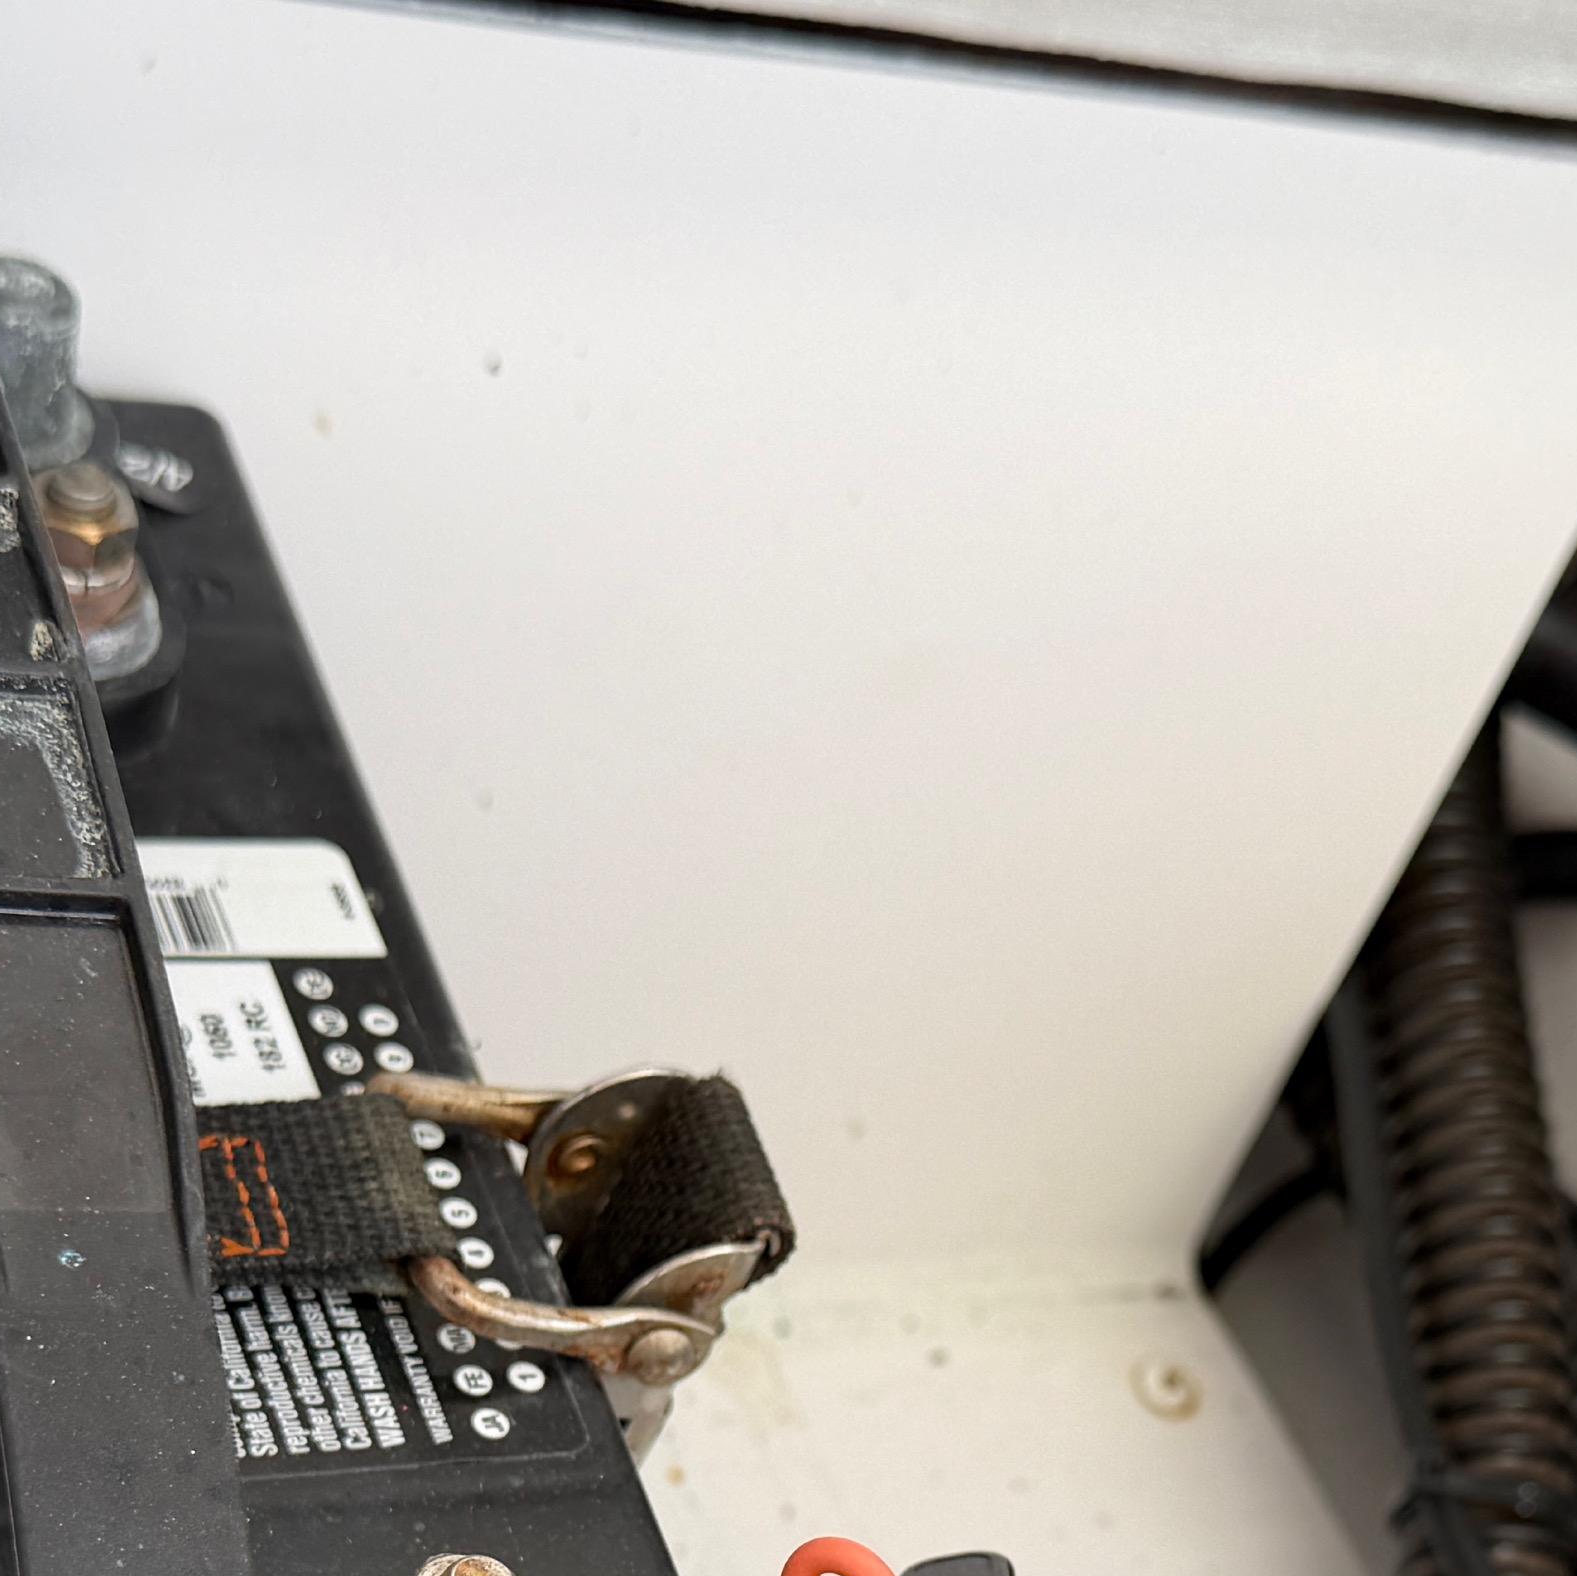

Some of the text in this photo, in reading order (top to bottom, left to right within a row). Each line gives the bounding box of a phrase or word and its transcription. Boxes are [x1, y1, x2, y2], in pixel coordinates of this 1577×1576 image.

[297, 1300, 336, 1350] cause
[384, 1315, 419, 1355] VOID
[274, 1323, 326, 1406] chemicals
[316, 1349, 344, 1369] to
[338, 1329, 386, 1391] HANDS
[253, 1351, 311, 1455] reproductive
[324, 1368, 373, 1451] California
[362, 1391, 406, 1448] WASH
[402, 1354, 454, 1446] WARRANTY
[241, 1410, 279, 1458] State
[306, 1406, 342, 1452] other
